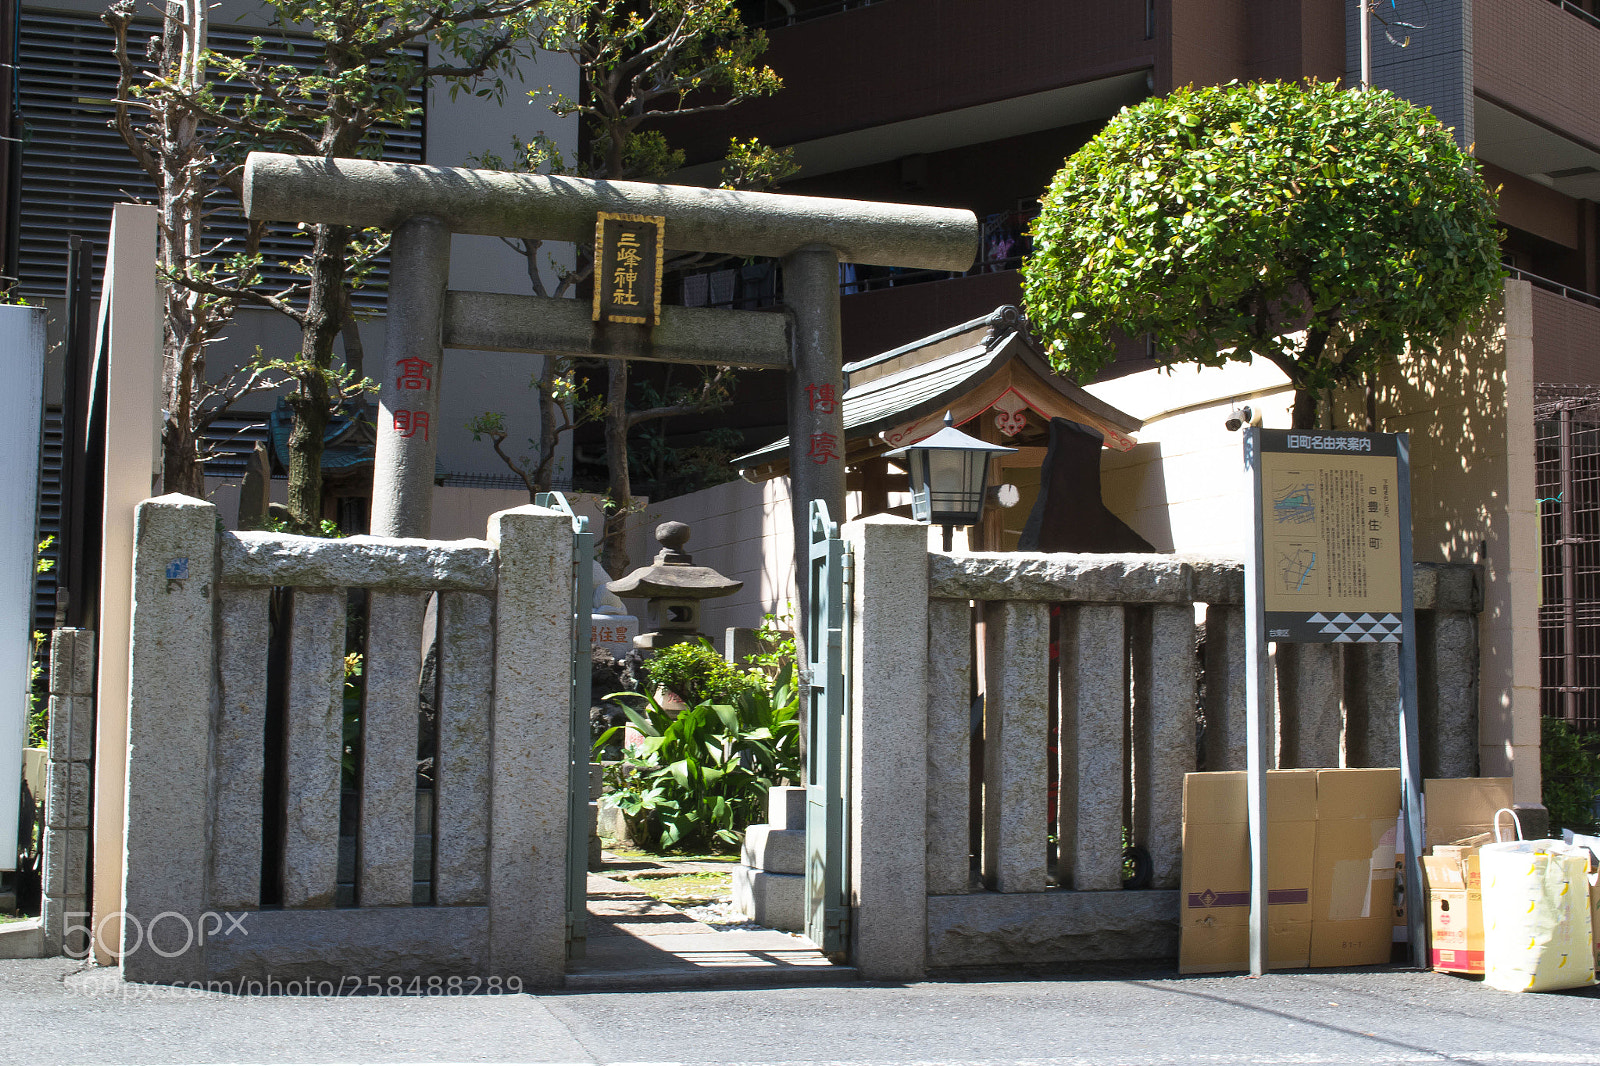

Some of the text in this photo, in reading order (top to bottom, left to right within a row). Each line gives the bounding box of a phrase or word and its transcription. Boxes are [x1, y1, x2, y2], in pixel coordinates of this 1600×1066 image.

[613, 232, 642, 306] 三峰神社
[1287, 434, 1371, 452] 旧町名由来案内
